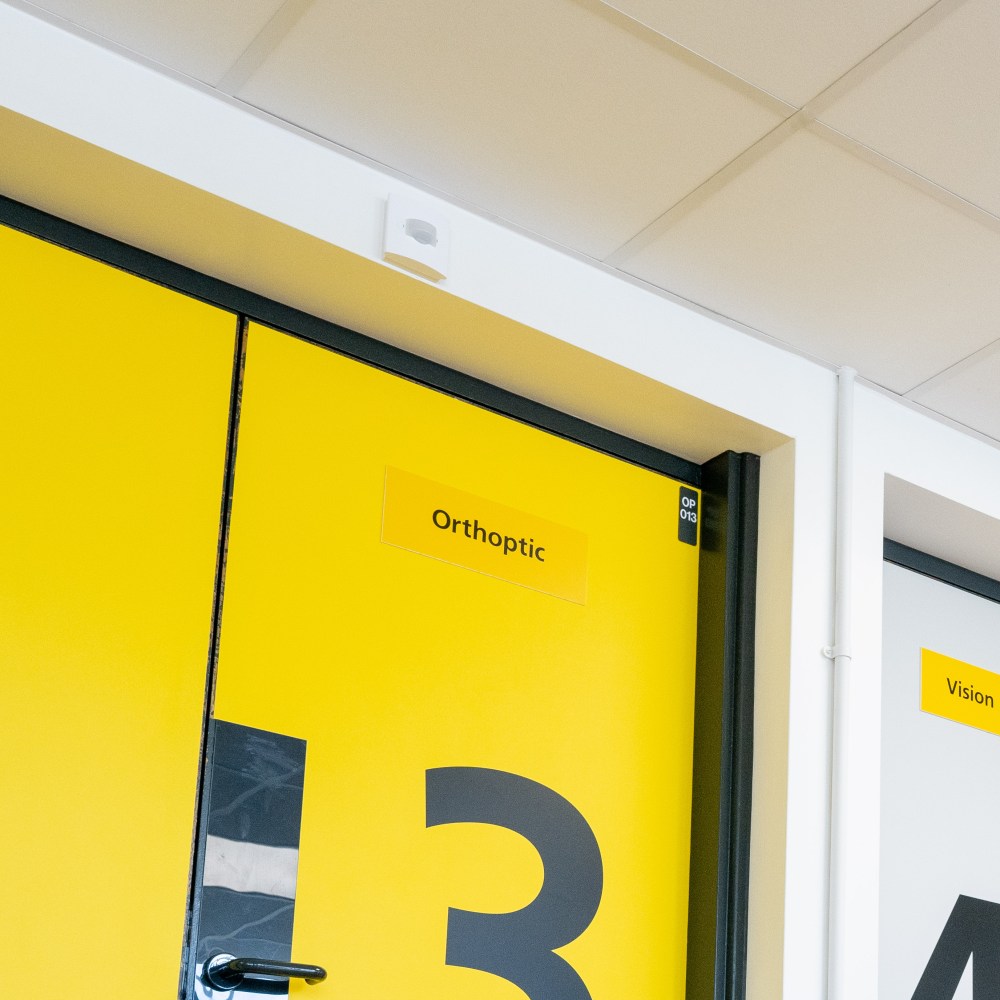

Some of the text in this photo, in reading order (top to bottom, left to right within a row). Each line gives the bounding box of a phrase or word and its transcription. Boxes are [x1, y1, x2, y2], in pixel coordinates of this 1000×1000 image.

[681, 496, 696, 509] OP
[680, 508, 697, 523] 013
[432, 509, 545, 562] Orthoptic
[946, 677, 994, 708] Vision
